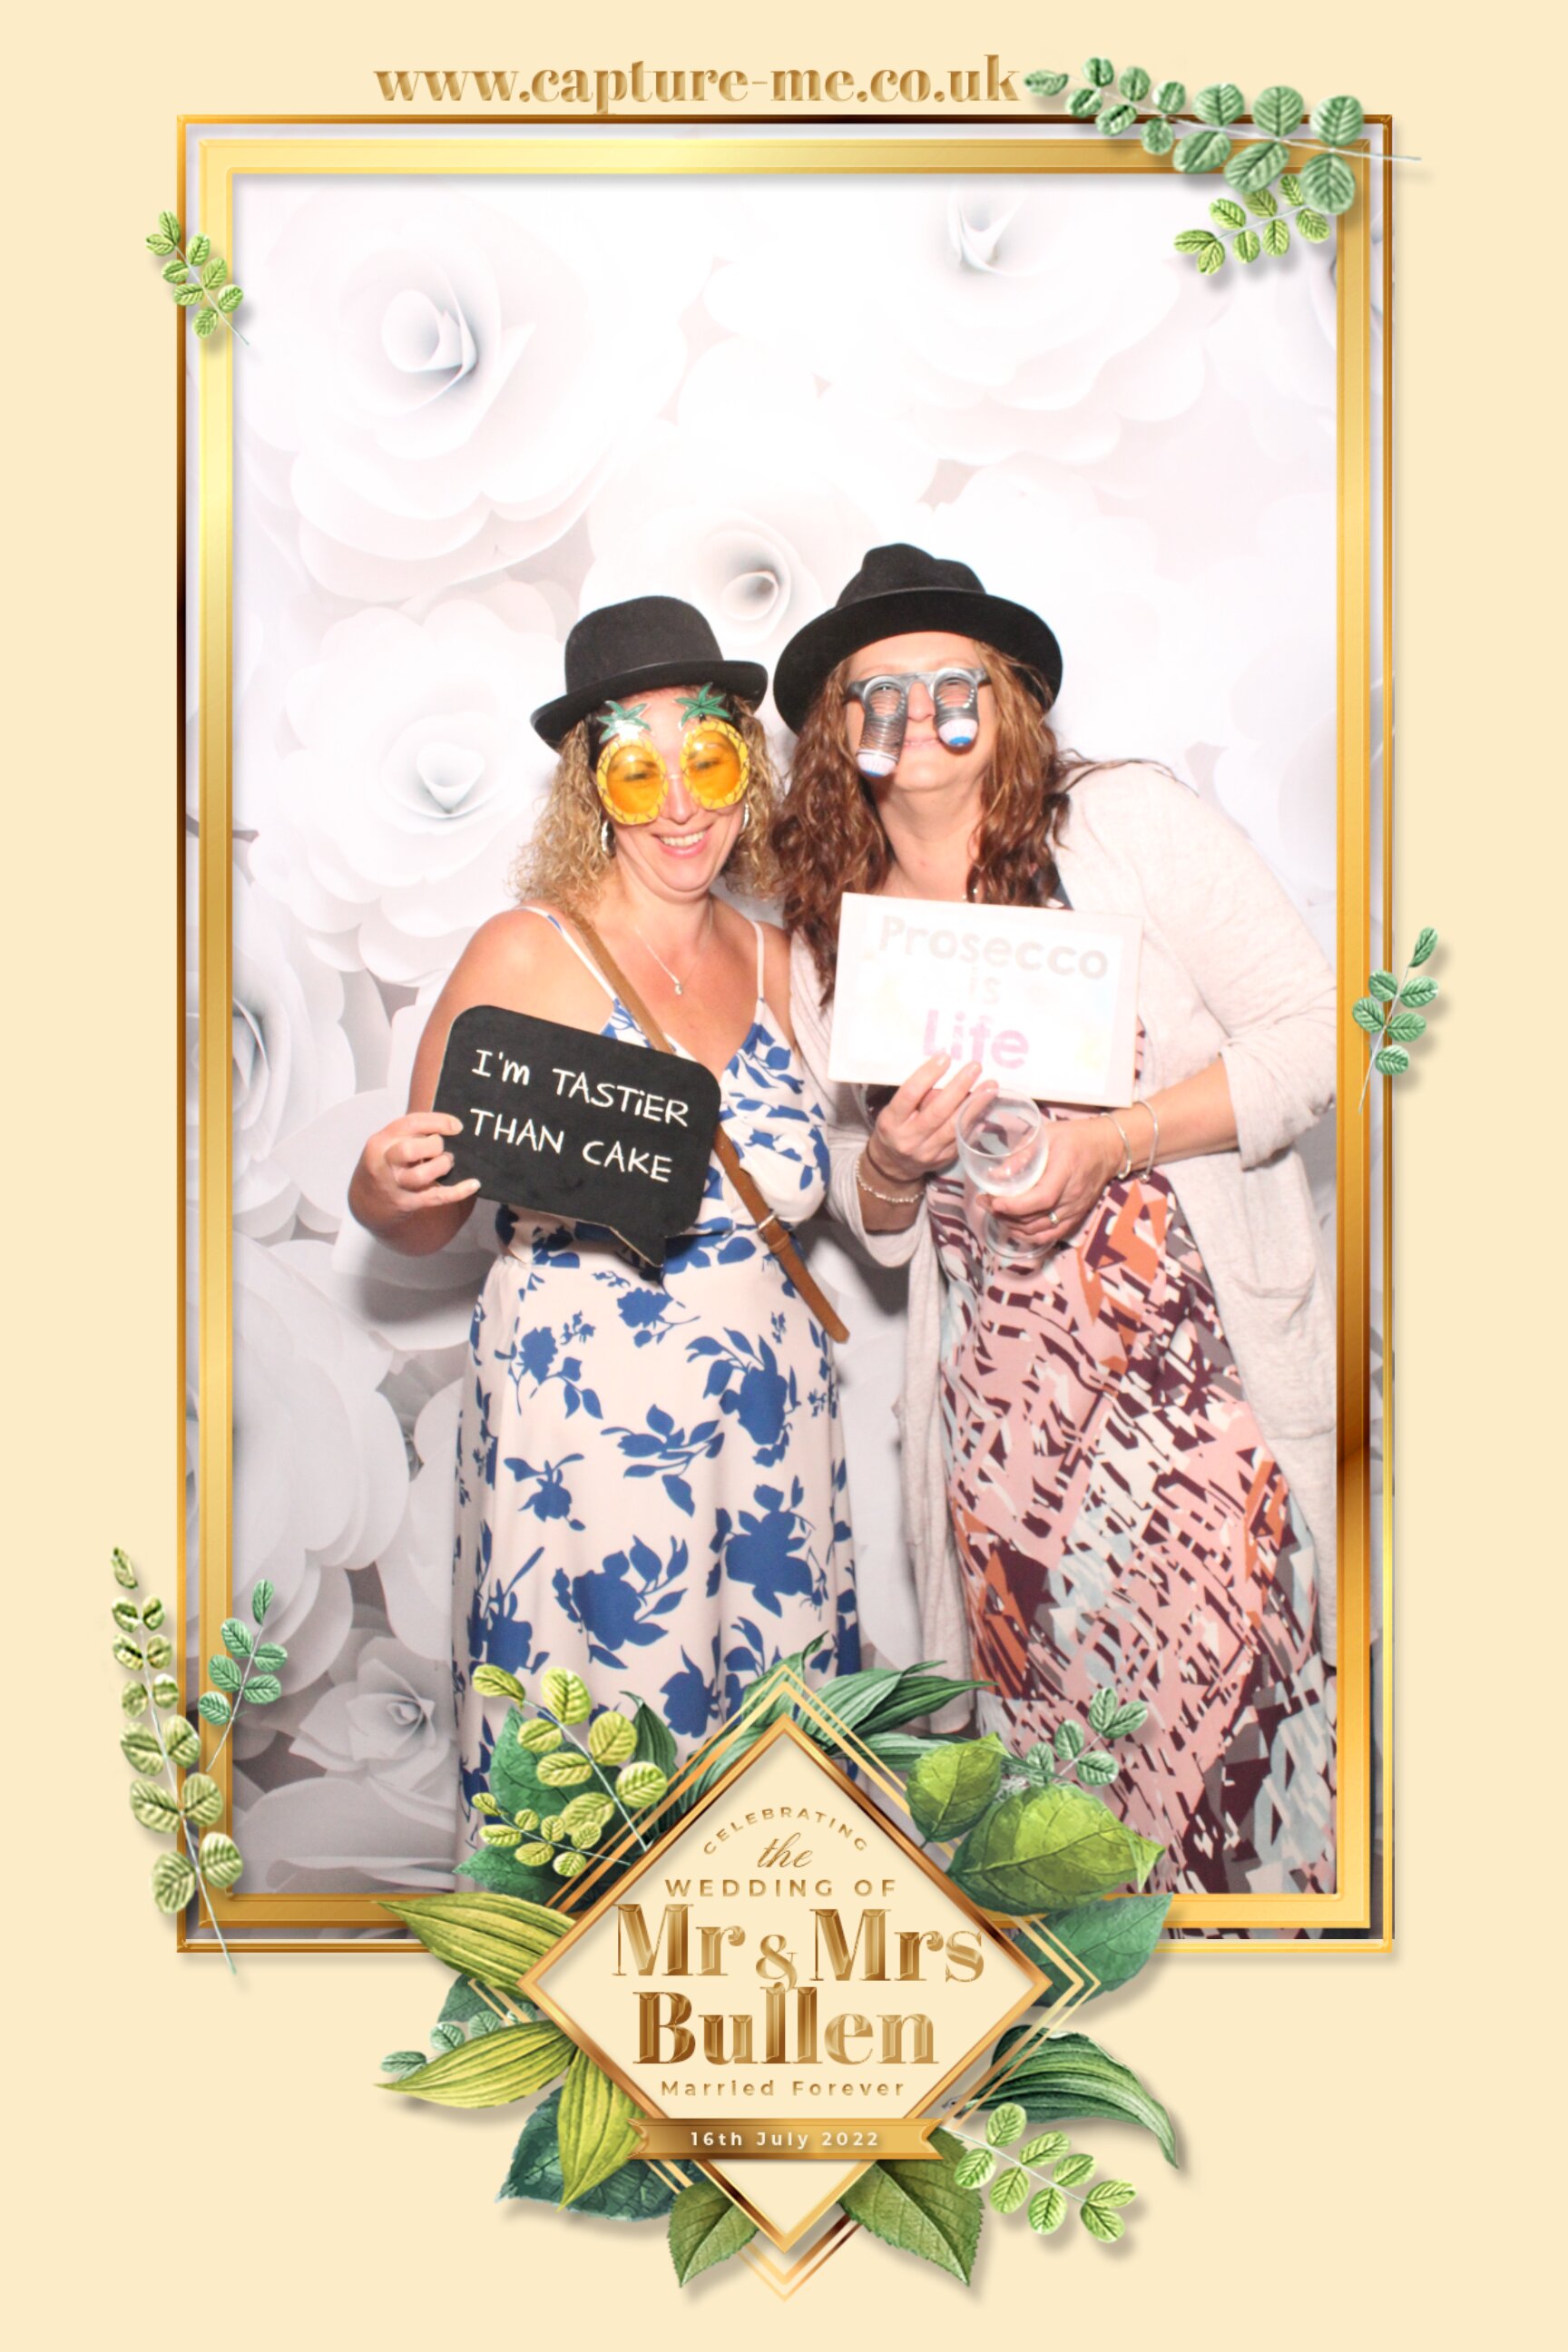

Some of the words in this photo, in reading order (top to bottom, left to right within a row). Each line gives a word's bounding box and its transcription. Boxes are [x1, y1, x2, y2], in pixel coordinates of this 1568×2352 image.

[878, 914, 1109, 981] Prosecco
[968, 966, 1002, 1005] is
[471, 1049, 530, 1086] I'm
[922, 1008, 1031, 1070] Life
[469, 1108, 565, 1155] THAN
[582, 1140, 673, 1183] CAKE
